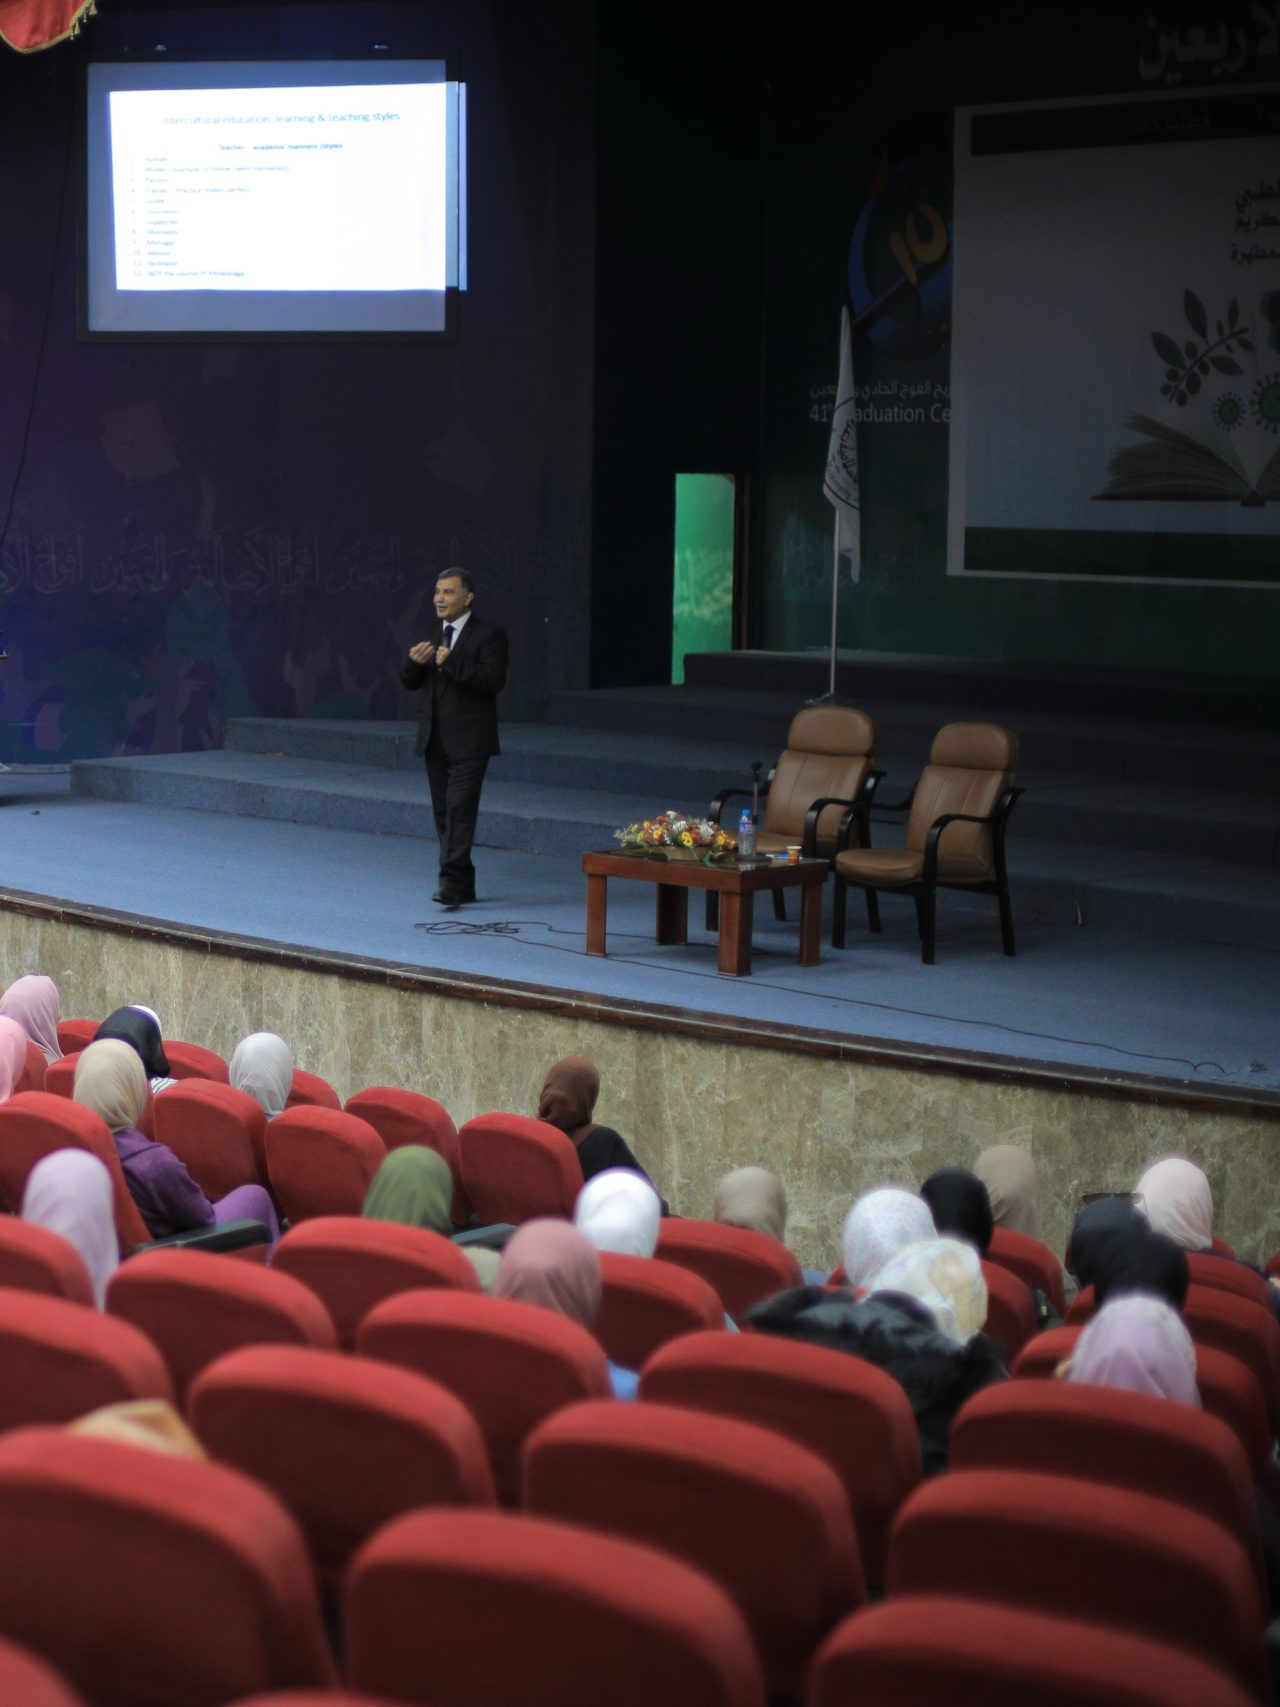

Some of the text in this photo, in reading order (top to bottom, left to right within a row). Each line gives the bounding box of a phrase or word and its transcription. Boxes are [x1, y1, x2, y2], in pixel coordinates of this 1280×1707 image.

[275, 114, 315, 124] learning
[317, 113, 325, 121] &
[329, 113, 370, 122] teaching
[373, 112, 400, 121] styles
[854, 403, 925, 422] aduation
